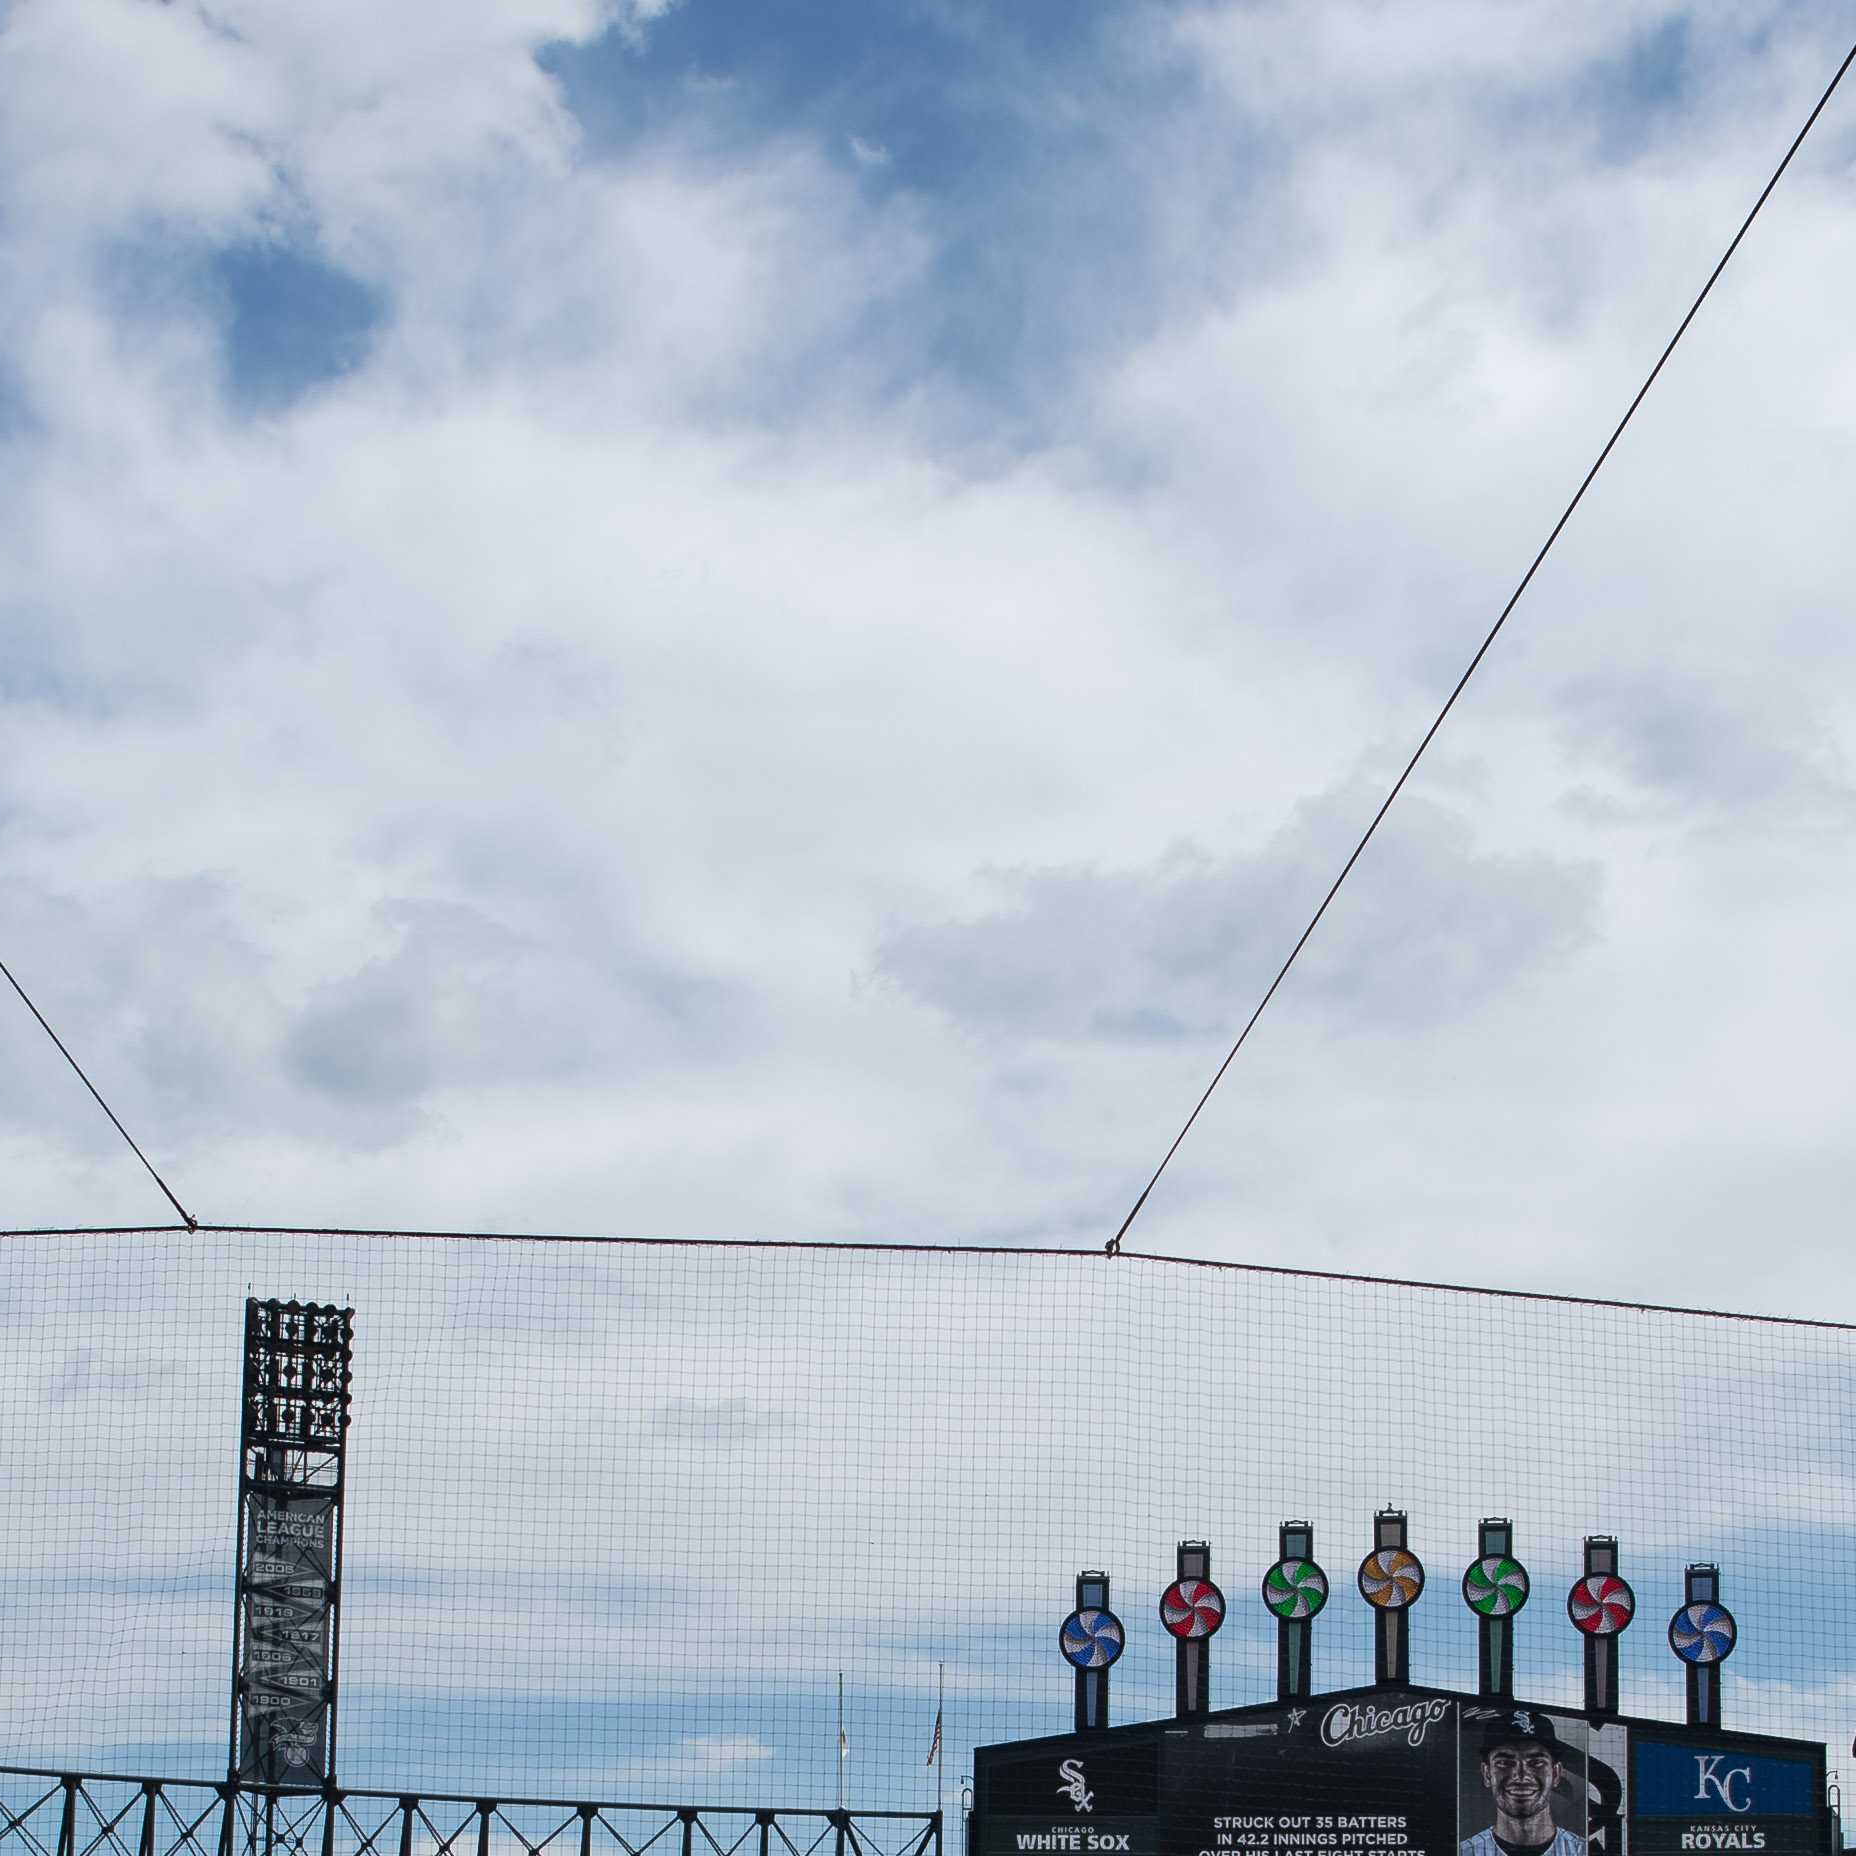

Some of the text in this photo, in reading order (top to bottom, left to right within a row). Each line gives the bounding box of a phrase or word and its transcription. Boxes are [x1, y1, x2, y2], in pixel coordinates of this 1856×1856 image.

[257, 1509, 325, 1524] AMERICAN
[257, 1521, 324, 1538] LEAGUE
[256, 1534, 324, 1548] CHAMPIONS
[1321, 1698, 1451, 1747] Chicago
[1214, 1817, 1406, 1828] STRUCK OUT 35 BATTERS
[1017, 1834, 1129, 1850] WHITE SOX
[1217, 1833, 1407, 1845] IN 42.2 INNINGS PITCHED
[1682, 1833, 1766, 1849] ROYALS
